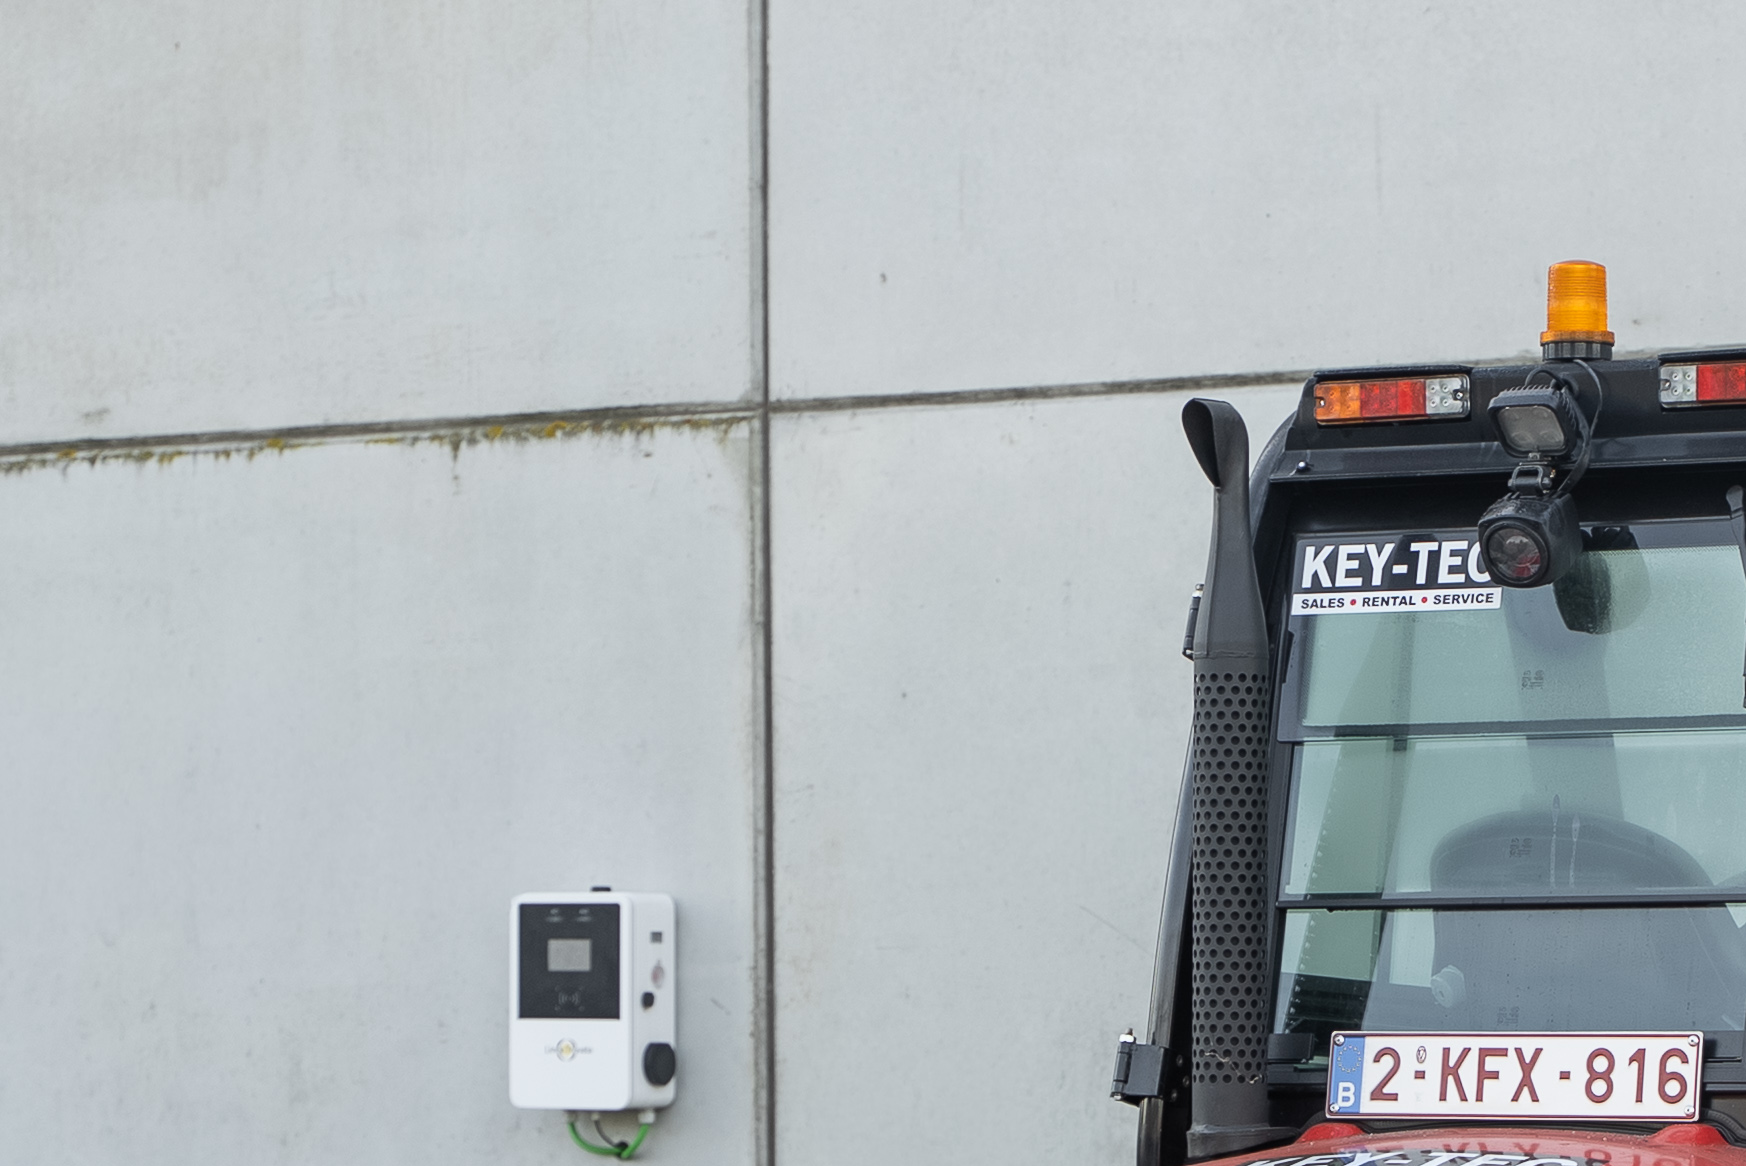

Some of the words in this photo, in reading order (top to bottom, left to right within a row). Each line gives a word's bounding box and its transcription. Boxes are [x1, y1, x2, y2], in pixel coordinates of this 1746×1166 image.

[1301, 598, 1344, 609] SALES
[1362, 595, 1416, 607] RENTAL
[1433, 593, 1494, 605] SERVICE
[1337, 1081, 1356, 1107] B
[1370, 1047, 1689, 1104] 2-KFX-816
